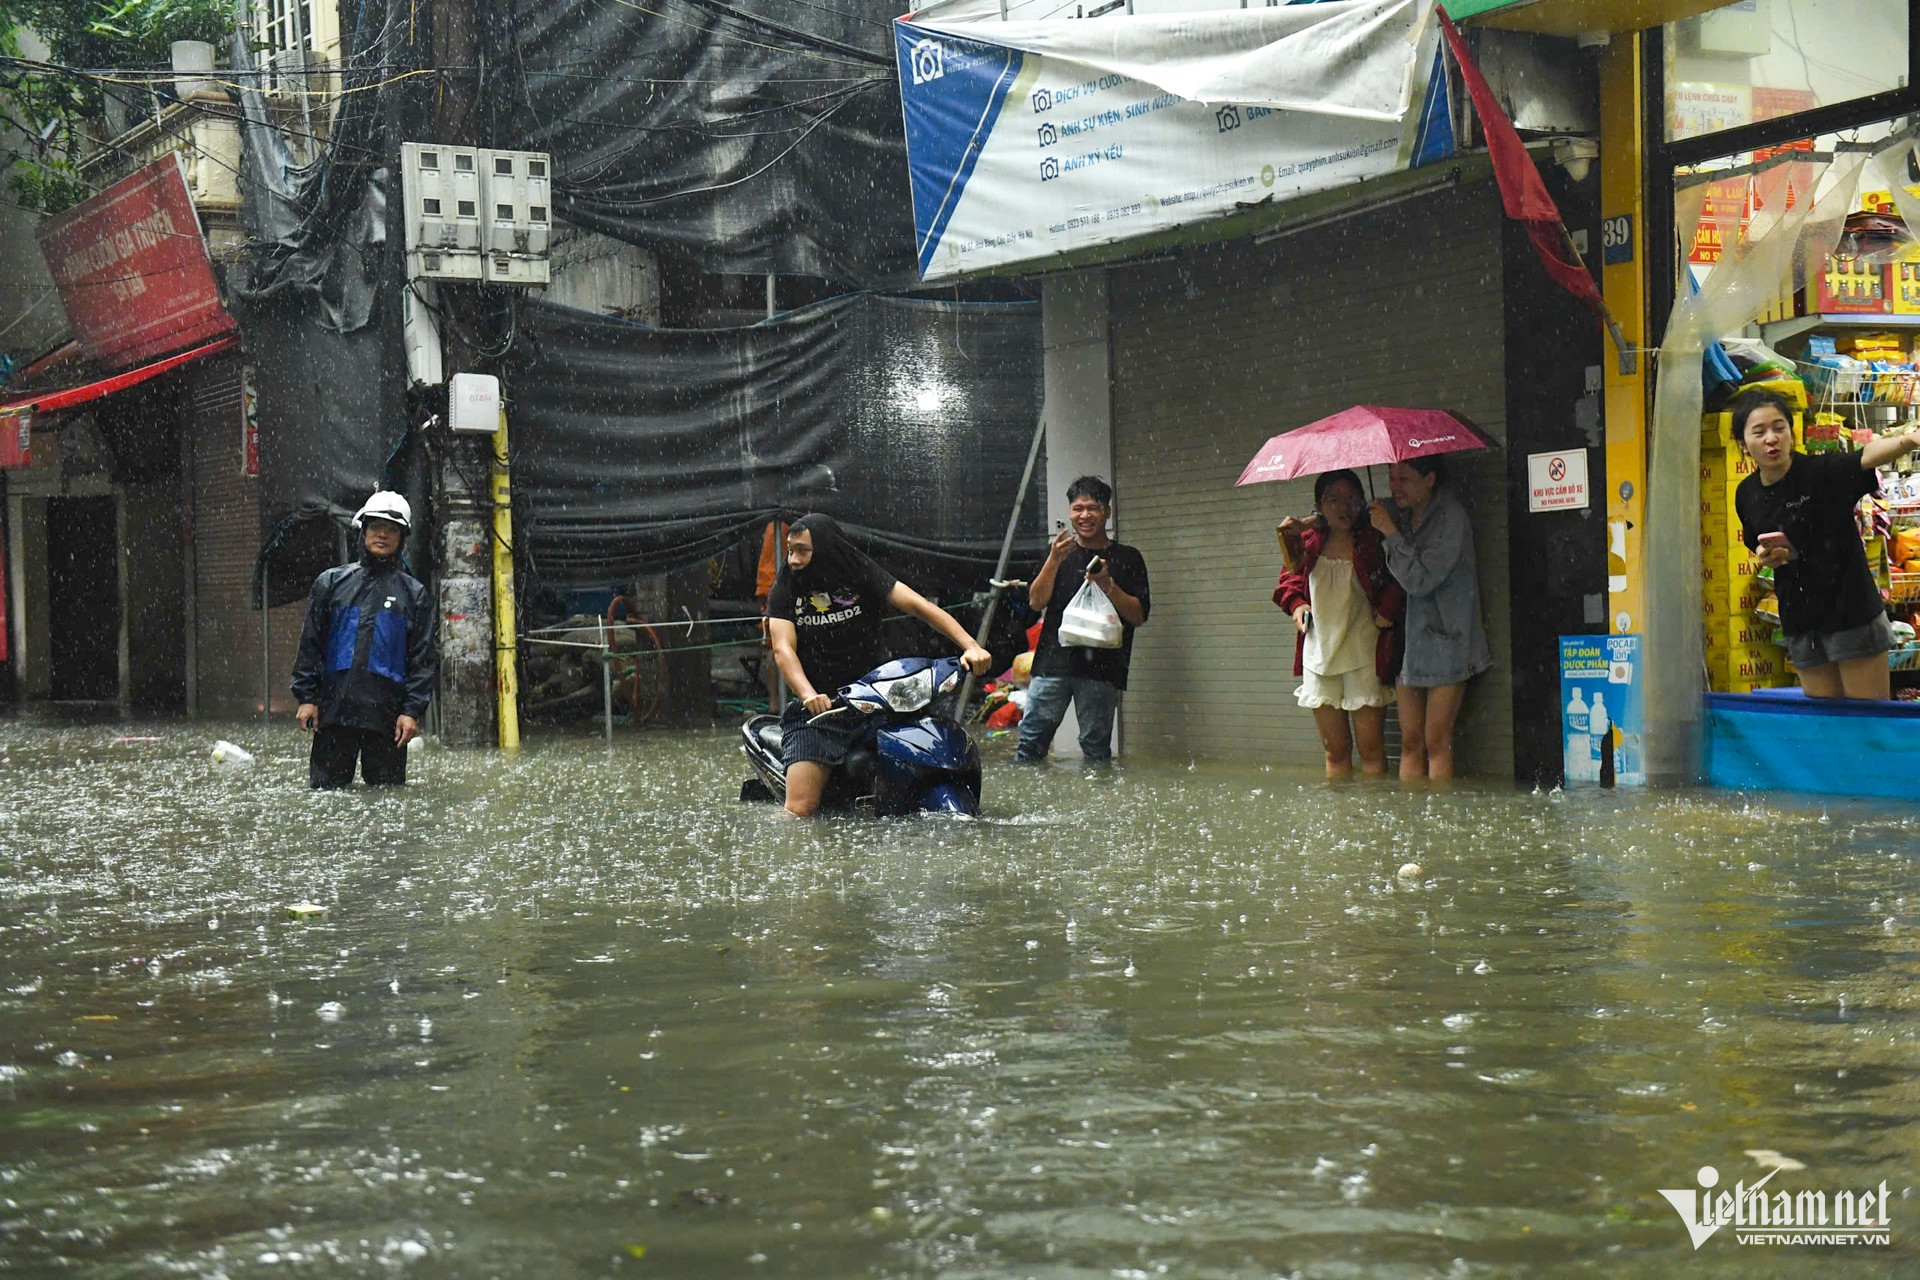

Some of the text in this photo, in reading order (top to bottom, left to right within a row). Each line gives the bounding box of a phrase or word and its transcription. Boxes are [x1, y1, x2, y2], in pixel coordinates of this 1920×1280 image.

[1056, 85, 1079, 104] DỊCH
[1083, 81, 1096, 97] VỤ
[1084, 115, 1096, 134] SỰ
[1125, 100, 1150, 119] SINH
[1104, 143, 1123, 161] YẾU
[1278, 164, 1296, 178] Email:
[1160, 194, 1183, 207] Website:
[1603, 217, 1629, 247] 39
[1697, 227, 1710, 243] CẤM
[1700, 251, 1710, 260] NO
[1534, 488, 1543, 497] KHU
[1545, 487, 1554, 497] VỰC
[1555, 484, 1567, 495] CẤM
[1577, 485, 1583, 493] XE
[1738, 560, 1751, 575] HÀ
[796, 605, 862, 627] SQUARED2
[1739, 627, 1754, 643] HÀ
[1563, 645, 1600, 659] TẬP ĐOÀN
[1563, 660, 1586, 671] DƯỢC
[1739, 658, 1773, 676] HÀ NỘI
